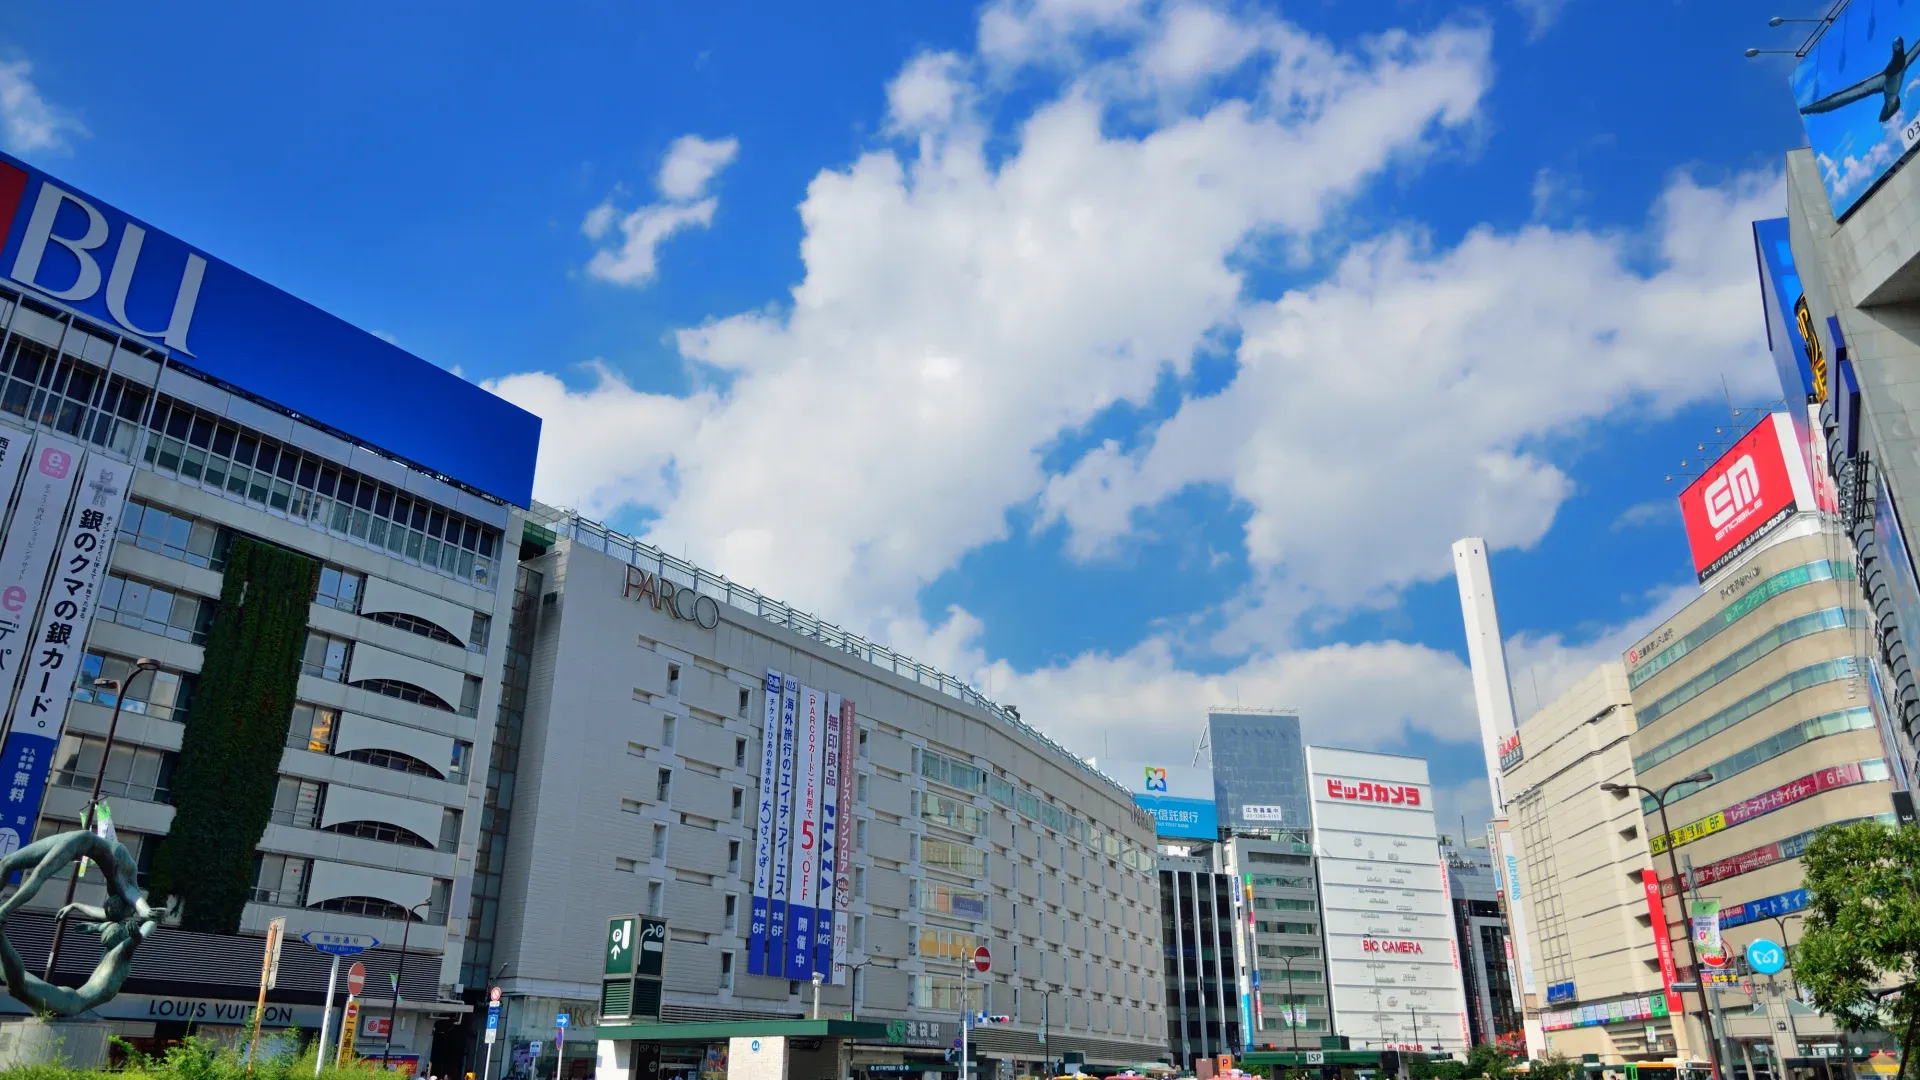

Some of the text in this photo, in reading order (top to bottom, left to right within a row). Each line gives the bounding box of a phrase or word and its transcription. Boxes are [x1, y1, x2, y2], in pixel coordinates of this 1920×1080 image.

[10, 181, 207, 358] BU
[624, 563, 720, 630] PARCO
[826, 714, 839, 787] 無印良品
[9, 771, 30, 803] 無料
[1326, 778, 1421, 806] ビックカメラ
[821, 804, 835, 891] PLAZA
[323, 935, 360, 945] 明治通り
[752, 922, 766, 934] 6F
[771, 925, 784, 937] 6F
[795, 916, 808, 968] 開催中
[1363, 939, 1423, 954] BIC CAMERA
[149, 999, 293, 1023] LOUIS VUITON
[907, 1022, 940, 1038] 池袋駅
[1308, 1053, 1322, 1063] ISP
